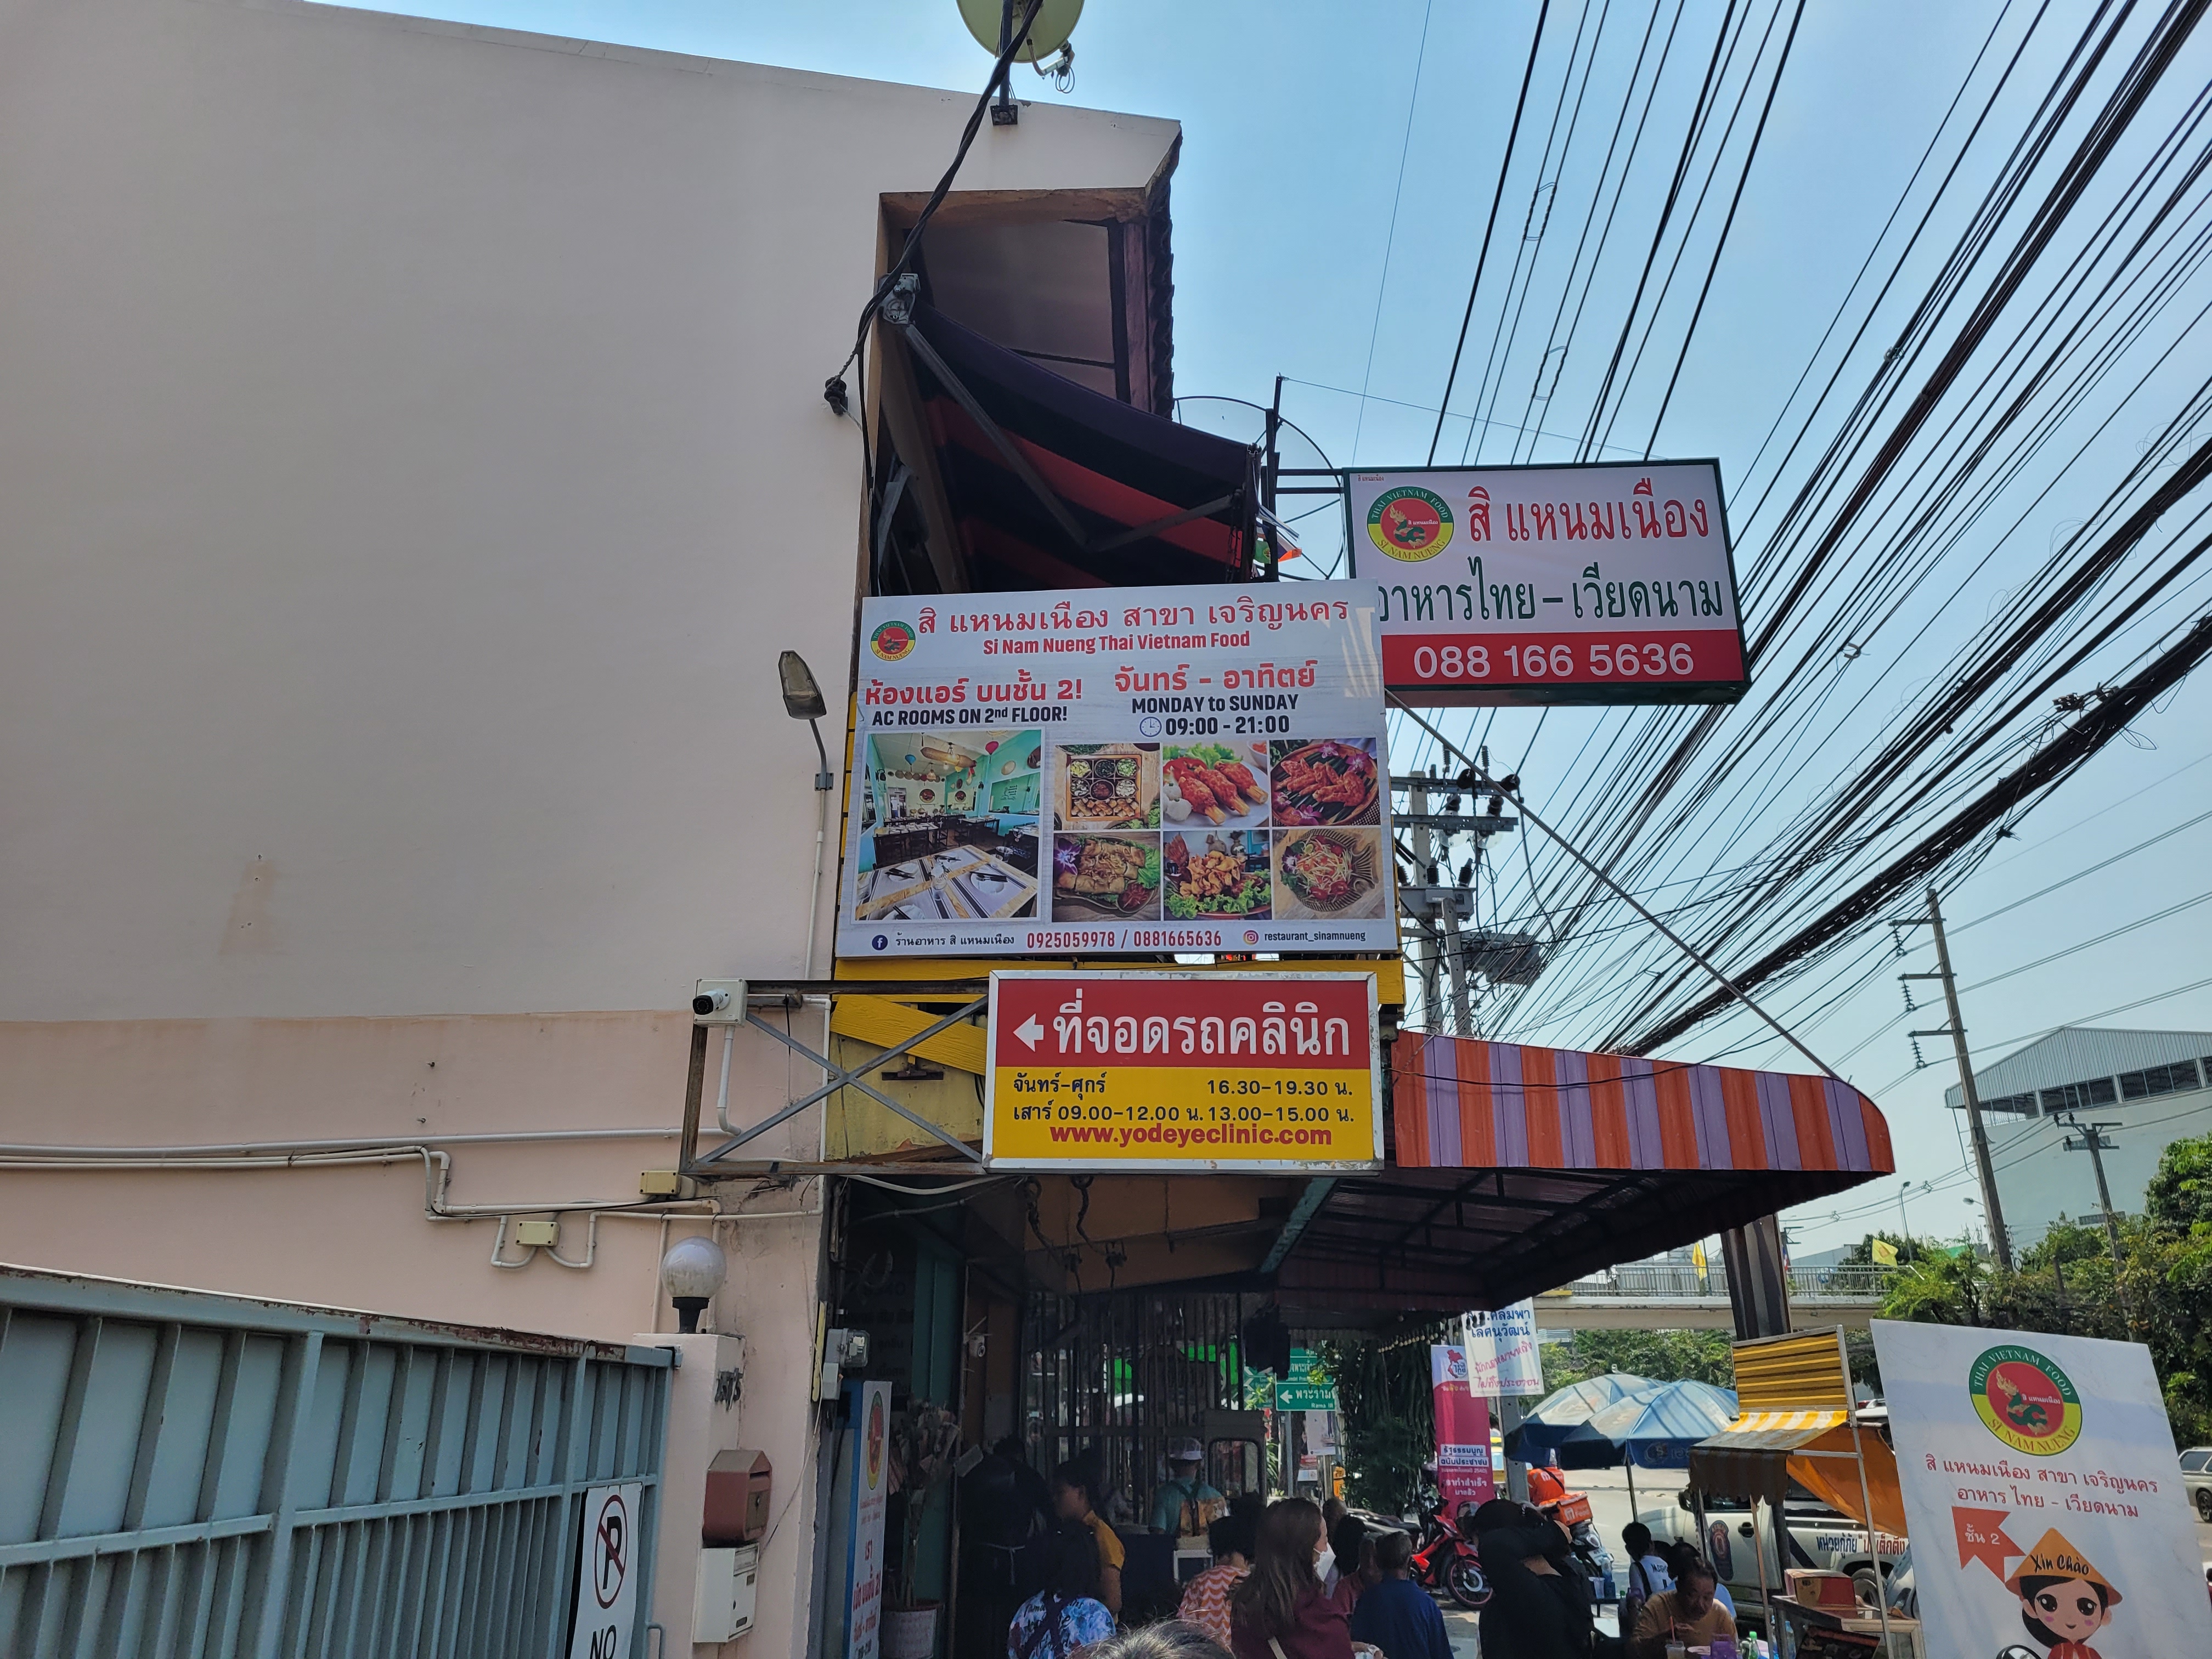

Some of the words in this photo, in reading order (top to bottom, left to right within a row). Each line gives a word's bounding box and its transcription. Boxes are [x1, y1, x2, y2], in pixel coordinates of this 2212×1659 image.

[1372, 500, 1386, 518] THAI
[1386, 489, 1427, 500] VIETNAM
[1430, 497, 1448, 518] FOOD
[1468, 486, 1491, 541] สิ
[1507, 477, 1709, 541] แหนมเนือง
[1378, 539, 1387, 548] SI
[1388, 546, 1412, 560] NAM
[1414, 539, 1446, 559] NUENG
[918, 607, 936, 634] สิ
[950, 601, 1108, 633] แหนมเนือง
[1124, 606, 1194, 627] สาขา
[1209, 596, 1349, 630] เจริญนคร
[983, 639, 998, 654] Si
[1002, 639, 1039, 654] Nam
[1043, 637, 1096, 654] Nueng
[1099, 634, 1133, 651] Thai
[1137, 633, 1206, 650] Vietnam
[1211, 630, 1250, 648] Food
[1414, 644, 1490, 679] 088
[1504, 644, 1575, 678] 166
[1589, 642, 1694, 676] 5636
[865, 678, 970, 705] ห้องแอร์
[977, 669, 1046, 702] บนชั้น
[1057, 679, 1082, 700] 2!
[1114, 664, 1190, 692] จันทร์
[1223, 660, 1318, 689] อาทิตย์
[872, 712, 894, 726] AC
[898, 709, 955, 726] ROOMS
[958, 709, 981, 724] ON
[984, 707, 1008, 723] 2nd
[1012, 706, 1068, 723] FLOOR!
[1132, 696, 1204, 714] MONDAY
[1208, 696, 1226, 712] to
[1229, 693, 1299, 711] SUNDAY
[1165, 717, 1218, 736] 09:00
[1235, 715, 1290, 734] 21:00
[895, 932, 946, 947] ร้านอาหาร
[950, 934, 957, 945] สิ
[960, 932, 1015, 946] แหนมเนือง
[1027, 931, 1115, 949] 0925059978
[1133, 930, 1222, 947] 0881665636
[1265, 930, 1366, 943] restaurant_sinamnueng
[1053, 988, 1350, 1056] ที่จอดรถคลินิก
[1013, 1071, 1107, 1101] จันทร์-ศุกร์
[1207, 1079, 1329, 1096] 16.30-19.30
[1335, 1082, 1353, 1096] น.
[1013, 1101, 1053, 1121] เสาร์
[1058, 1105, 1180, 1121] 09.00-12.00
[1187, 1108, 1204, 1121] น.
[1208, 1106, 1330, 1122] 13.00-15.00
[1336, 1108, 1355, 1123] น.
[1049, 1122, 1332, 1148] www.yodeyeclinic.com
[1974, 1362, 1989, 1387] THAI
[1988, 1350, 2040, 1365] VIETNAM
[2045, 1365, 2071, 1396] FOOD
[1989, 1418, 2002, 1432] SI
[2004, 1430, 2034, 1452] NAM
[2037, 1426, 2075, 1452] NUENG
[1926, 1454, 1937, 1471] สิ
[1943, 1459, 2030, 1480] แหนมเนือง
[2038, 1468, 2077, 1485] สาขา
[2083, 1470, 2158, 1495] เจริญนคร
[1957, 1487, 2006, 1504] อาหาร
[2010, 1485, 2044, 1508] ไทย
[2066, 1493, 2139, 1518] เวียดนาม
[1965, 1523, 1986, 1544] ชั้น
[1990, 1533, 2000, 1545] 2
[2030, 1553, 2053, 1573] Xin
[2056, 1555, 2090, 1576] Chào
[590, 1624, 617, 1659] NO
